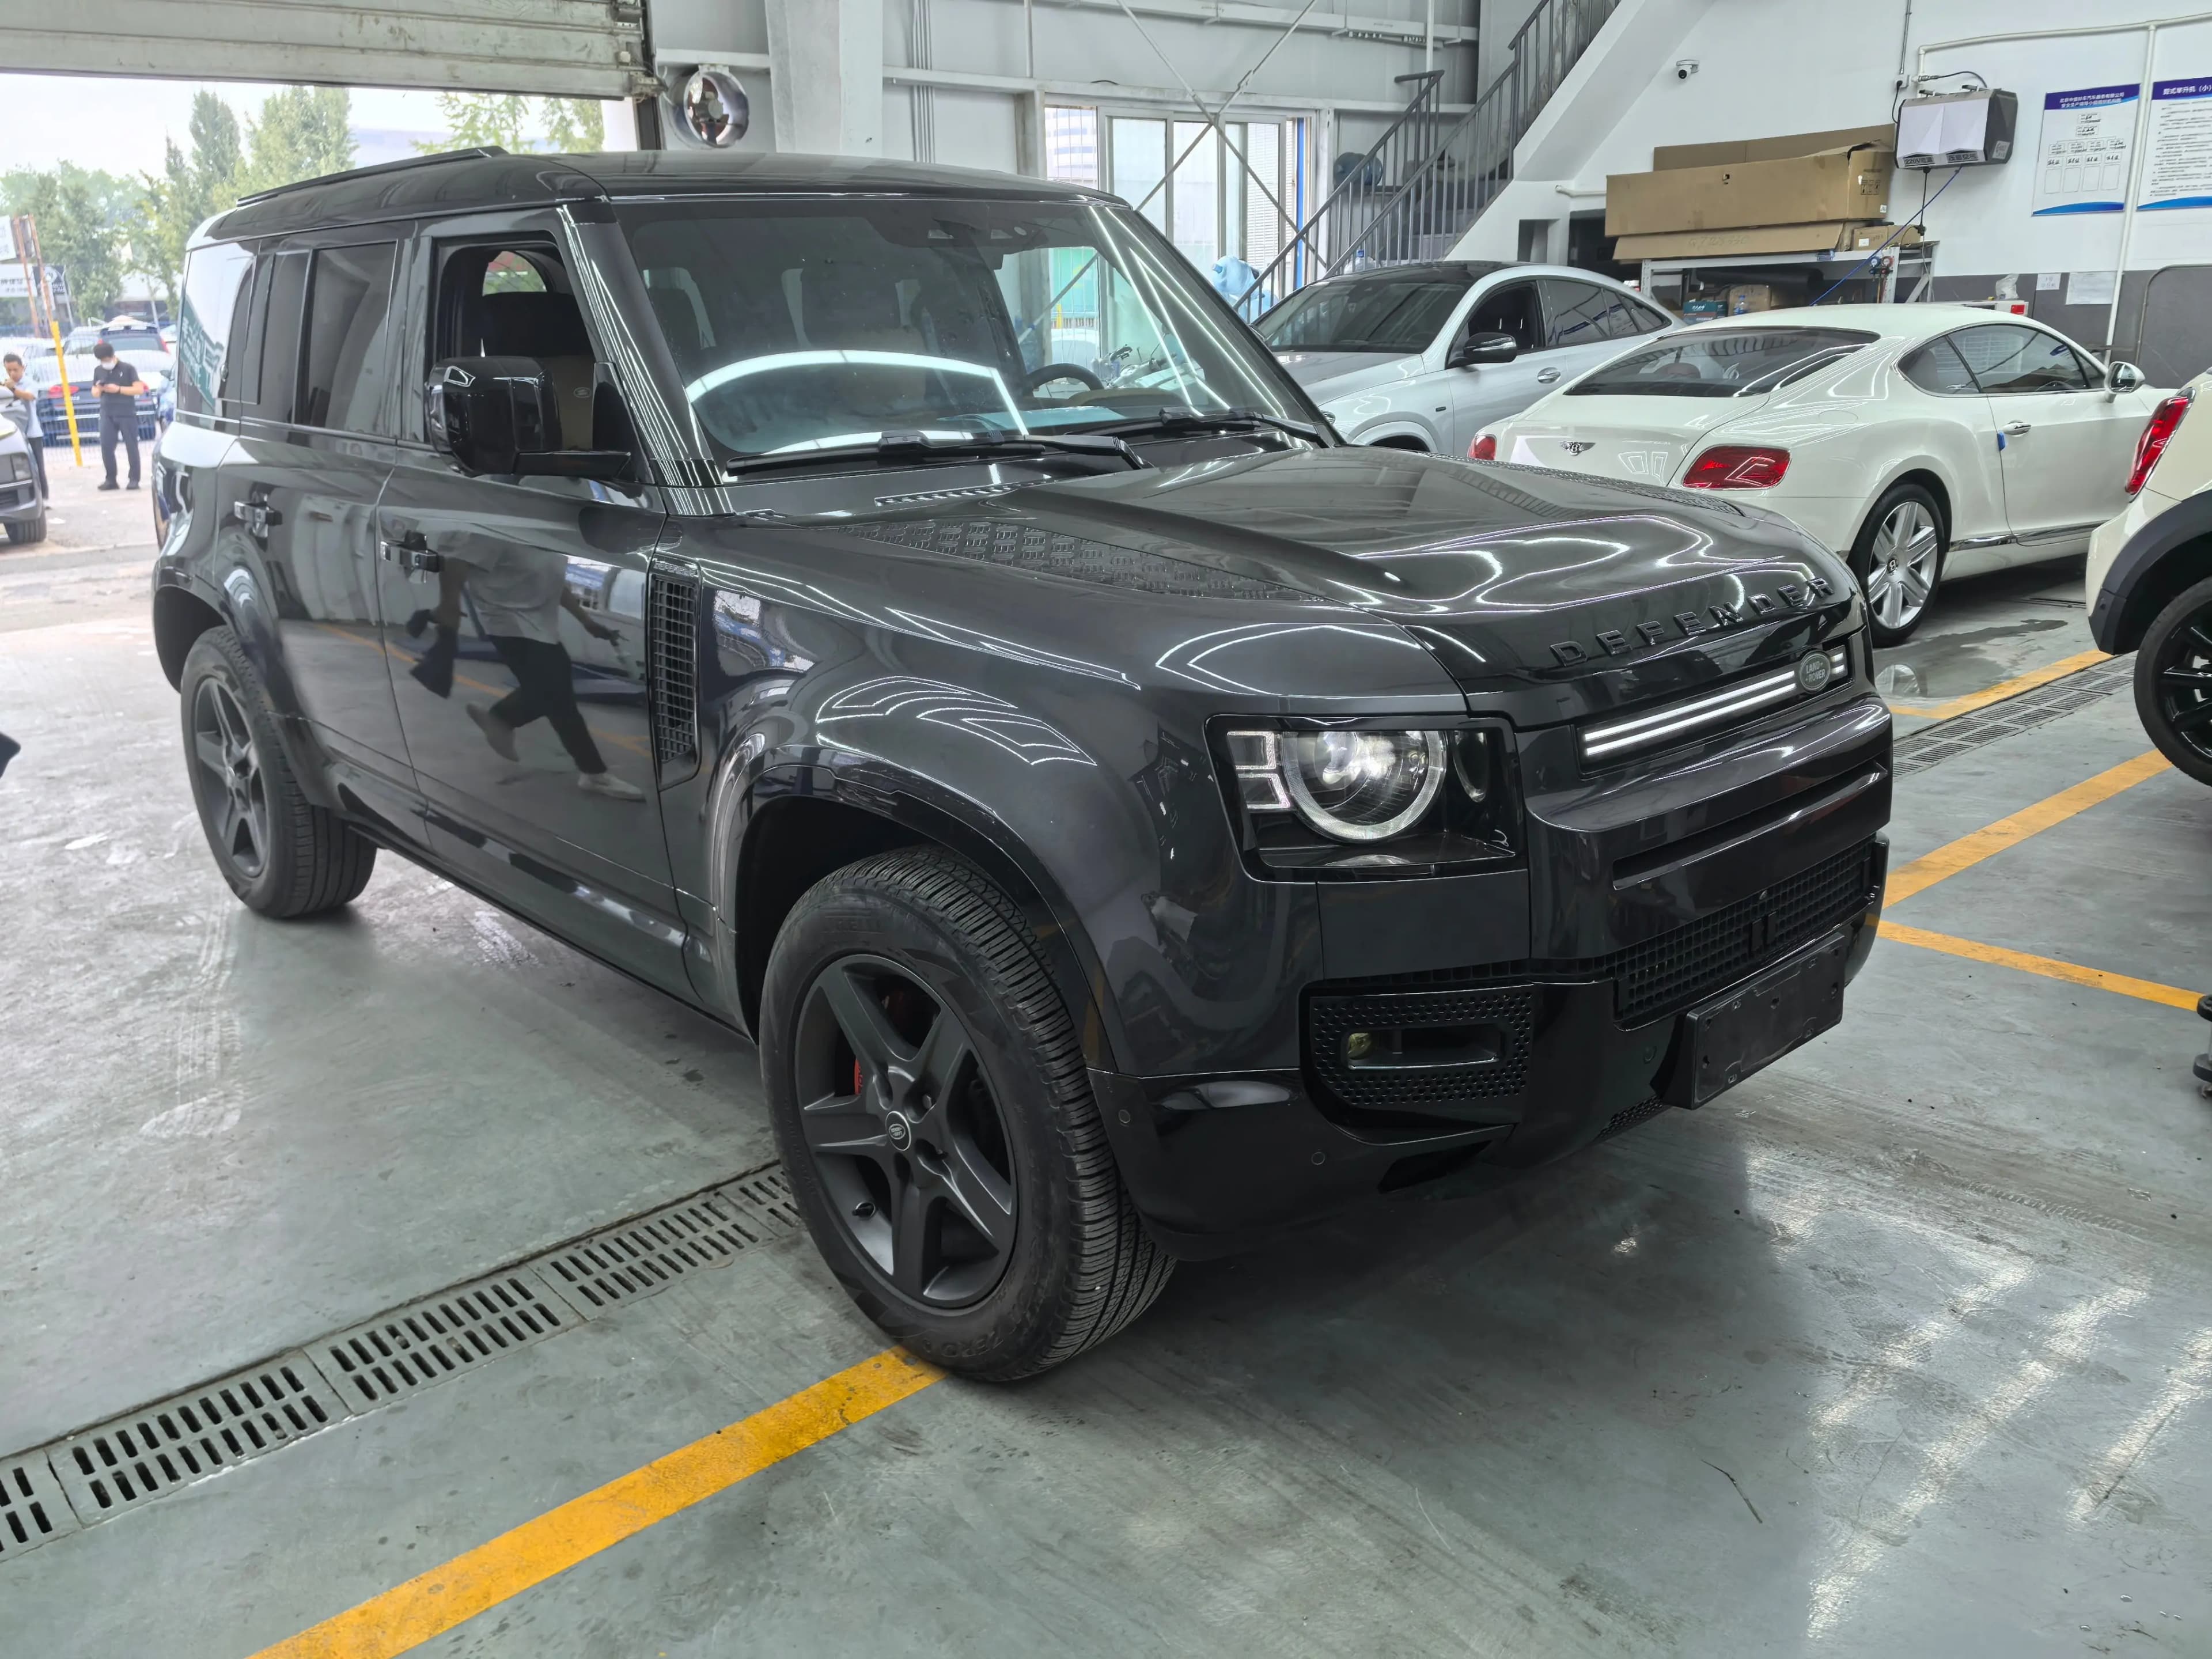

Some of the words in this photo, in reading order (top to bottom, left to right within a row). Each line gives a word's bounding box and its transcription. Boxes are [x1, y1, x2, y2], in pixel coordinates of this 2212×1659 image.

[1550, 578, 1835, 666] DEFENDER
[1806, 661, 1820, 674] LAND
[1808, 669, 1825, 682] ROVER
